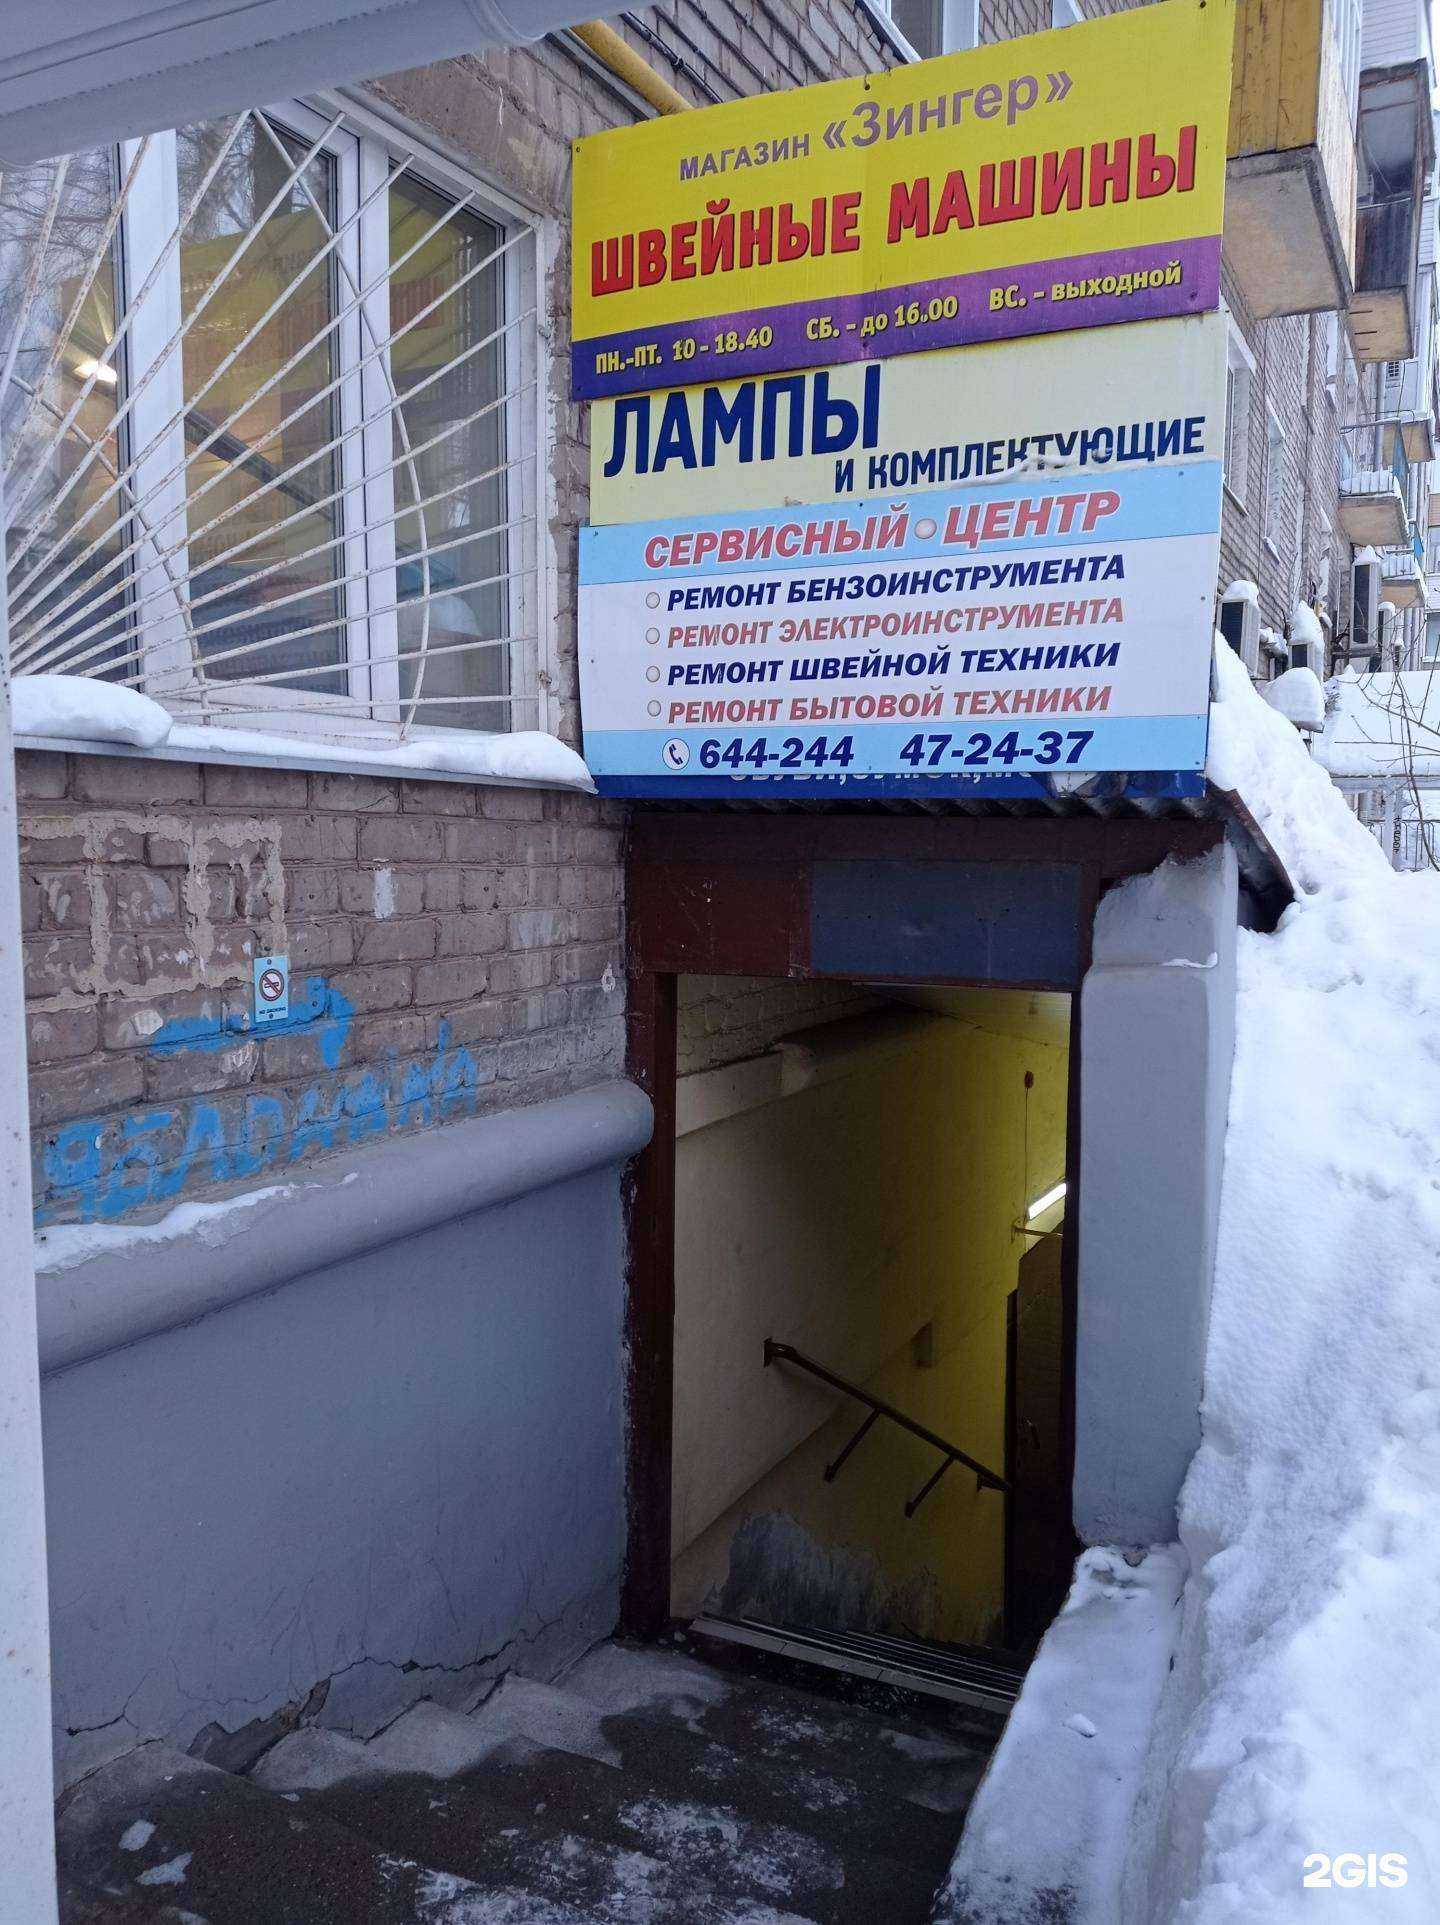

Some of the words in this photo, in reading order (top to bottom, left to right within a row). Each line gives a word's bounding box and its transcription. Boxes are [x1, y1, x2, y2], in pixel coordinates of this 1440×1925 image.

[680, 132, 810, 181] МАГАЗИН
[822, 70, 1073, 149] «Зингер»
[591, 190, 862, 297] ШВЕЙНЫЕ
[887, 124, 1197, 244] МАШИНЫ
[595, 343, 663, 375] ПН.-ПТ.
[672, 338, 696, 361] 10
[714, 325, 773, 355] 18.40
[806, 316, 840, 340] СБ.
[860, 312, 888, 337] до
[893, 295, 958, 327] 16.00
[988, 285, 1027, 311] ВС.
[1051, 260, 1182, 302] выходной
[603, 363, 881, 478] ЛАМПЫ
[835, 457, 854, 494] И
[643, 502, 910, 570] СЕРВИСНЫЙ
[942, 490, 1121, 548] ЦЕНТР
[666, 581, 782, 612] РЕМОНТ
[786, 553, 1125, 604] БЕНЗОИНСТРУМЕНТА
[667, 620, 773, 649] РЕМОНТ
[778, 597, 1124, 643] ЭЛЕКТРОИНСТРУМЕНТА
[667, 659, 783, 686] РЕМОНТ
[789, 644, 950, 682] ШВЕЙНОЙ
[960, 642, 1121, 674] ТЕХНИКИ
[668, 698, 783, 724] РЕМОНТ
[789, 685, 945, 721] БЫТОВОЙ
[953, 685, 1113, 716] ТЕХНИКИ
[699, 735, 854, 769] 644-244
[899, 730, 1094, 766] 47-24-37
